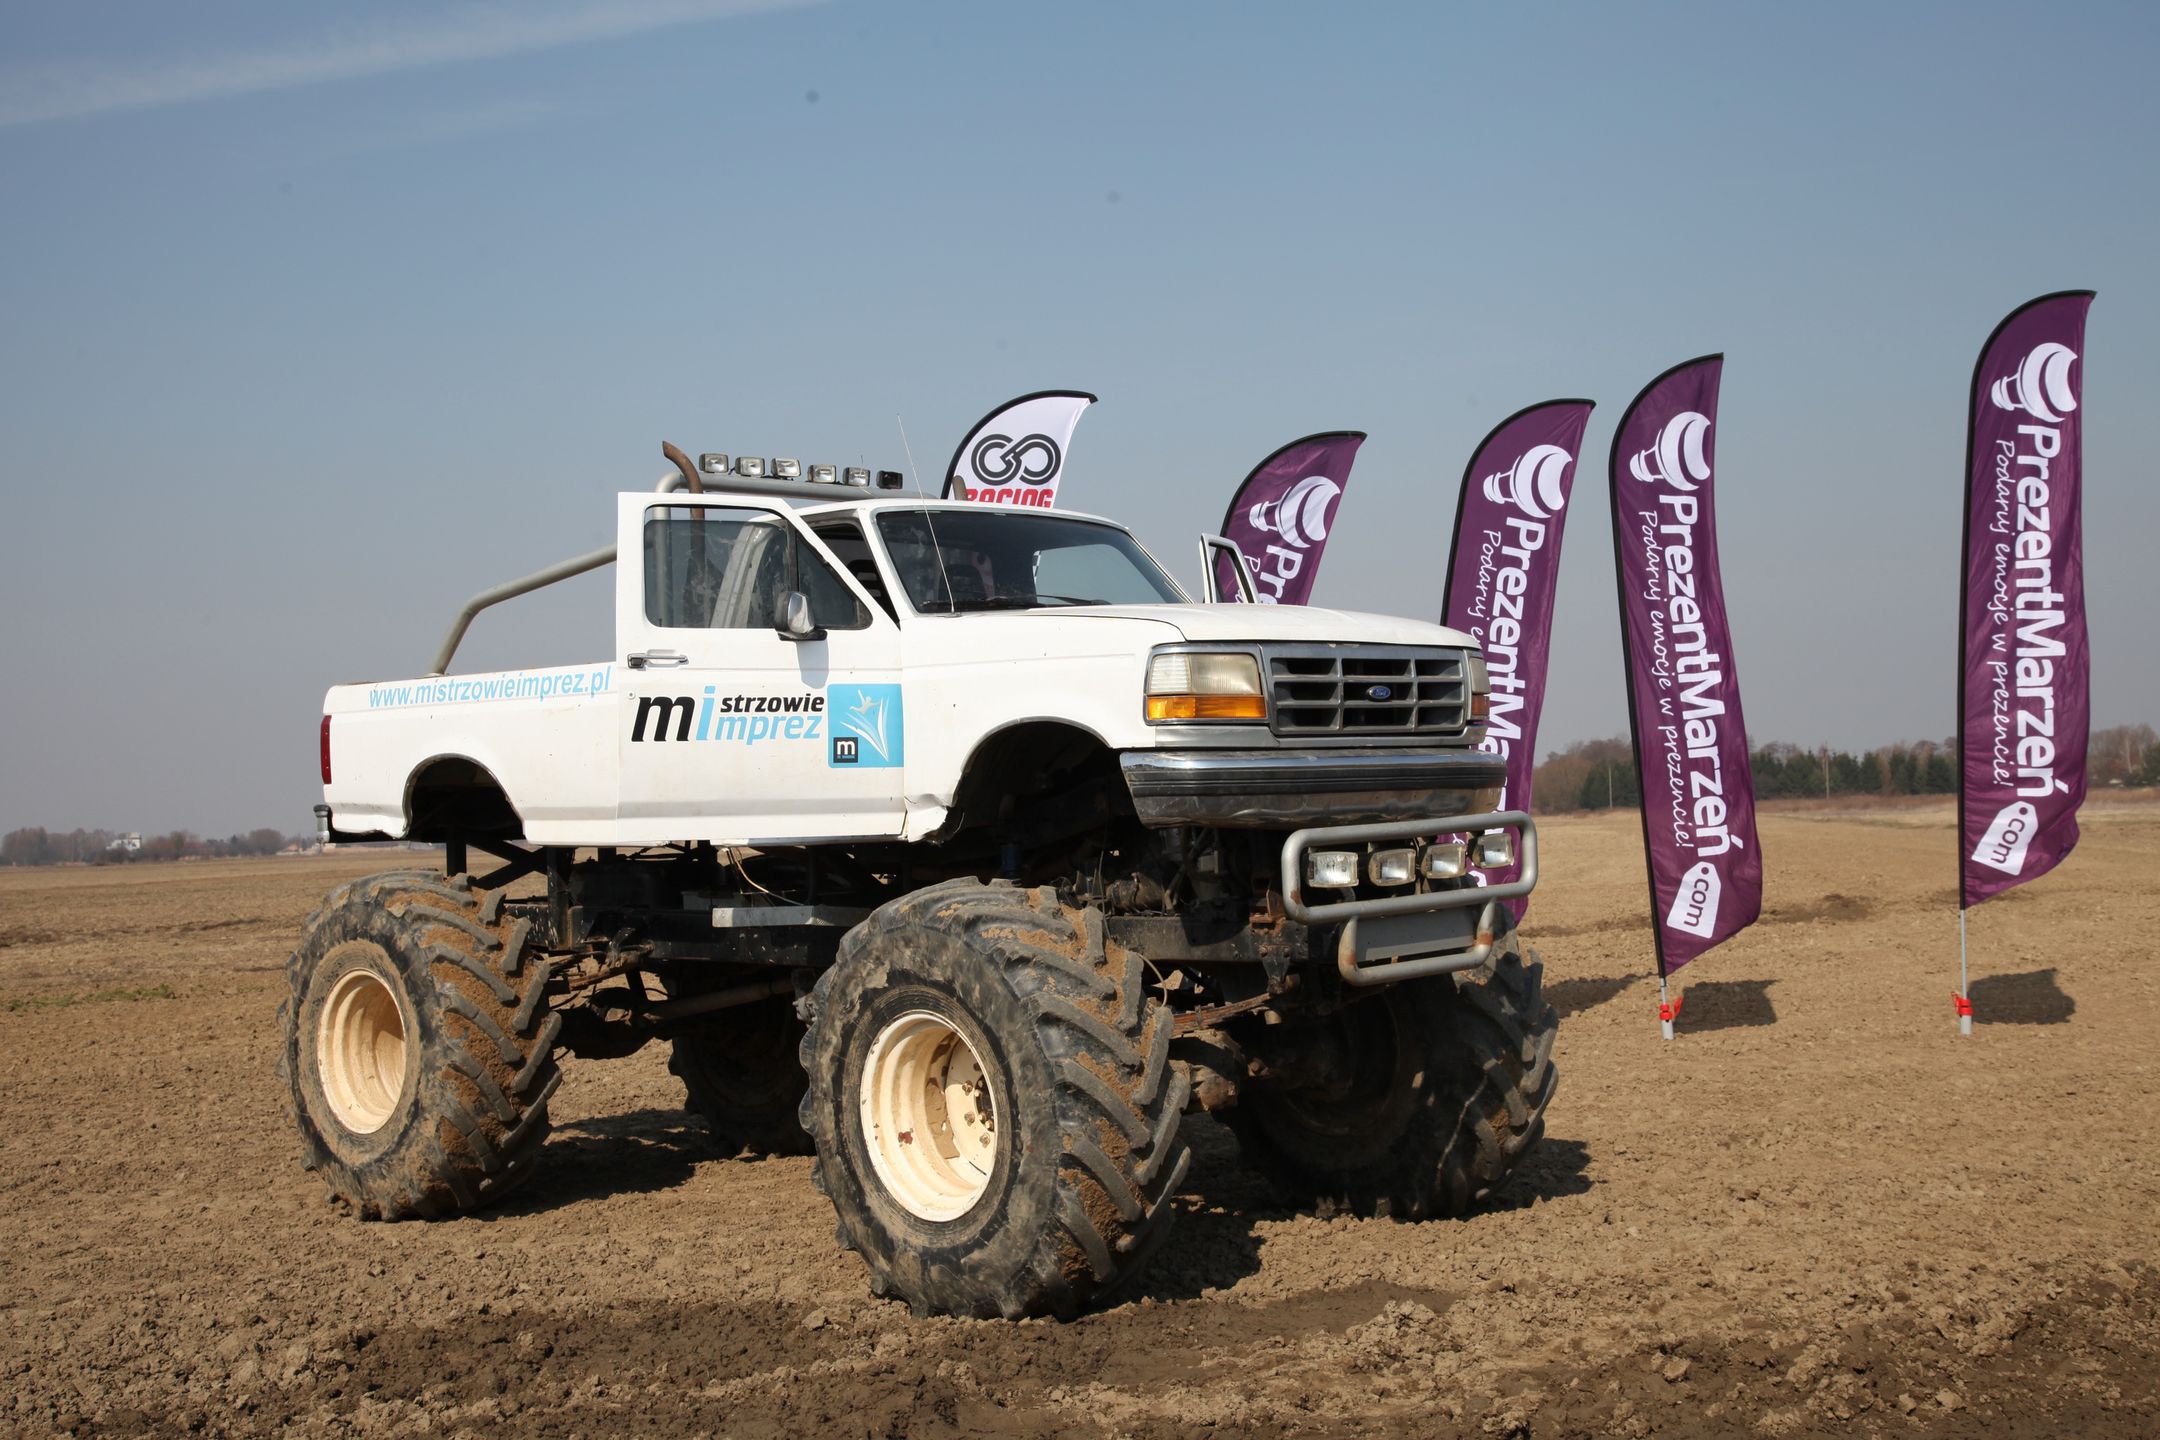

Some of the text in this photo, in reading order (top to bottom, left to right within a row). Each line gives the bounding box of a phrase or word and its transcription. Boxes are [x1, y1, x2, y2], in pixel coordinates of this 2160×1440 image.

[368, 665, 613, 708] www.mistrzowieimprez.pl
[1467, 530, 1501, 621] Podaruj
[1638, 510, 1695, 848] Podaruj emocje w prezencie!
[1659, 494, 1744, 857] PrezentMarzeń
[1986, 440, 2016, 787] Podaruj emocje w prezencie!
[2015, 424, 2069, 797] PrezentMarzeń
